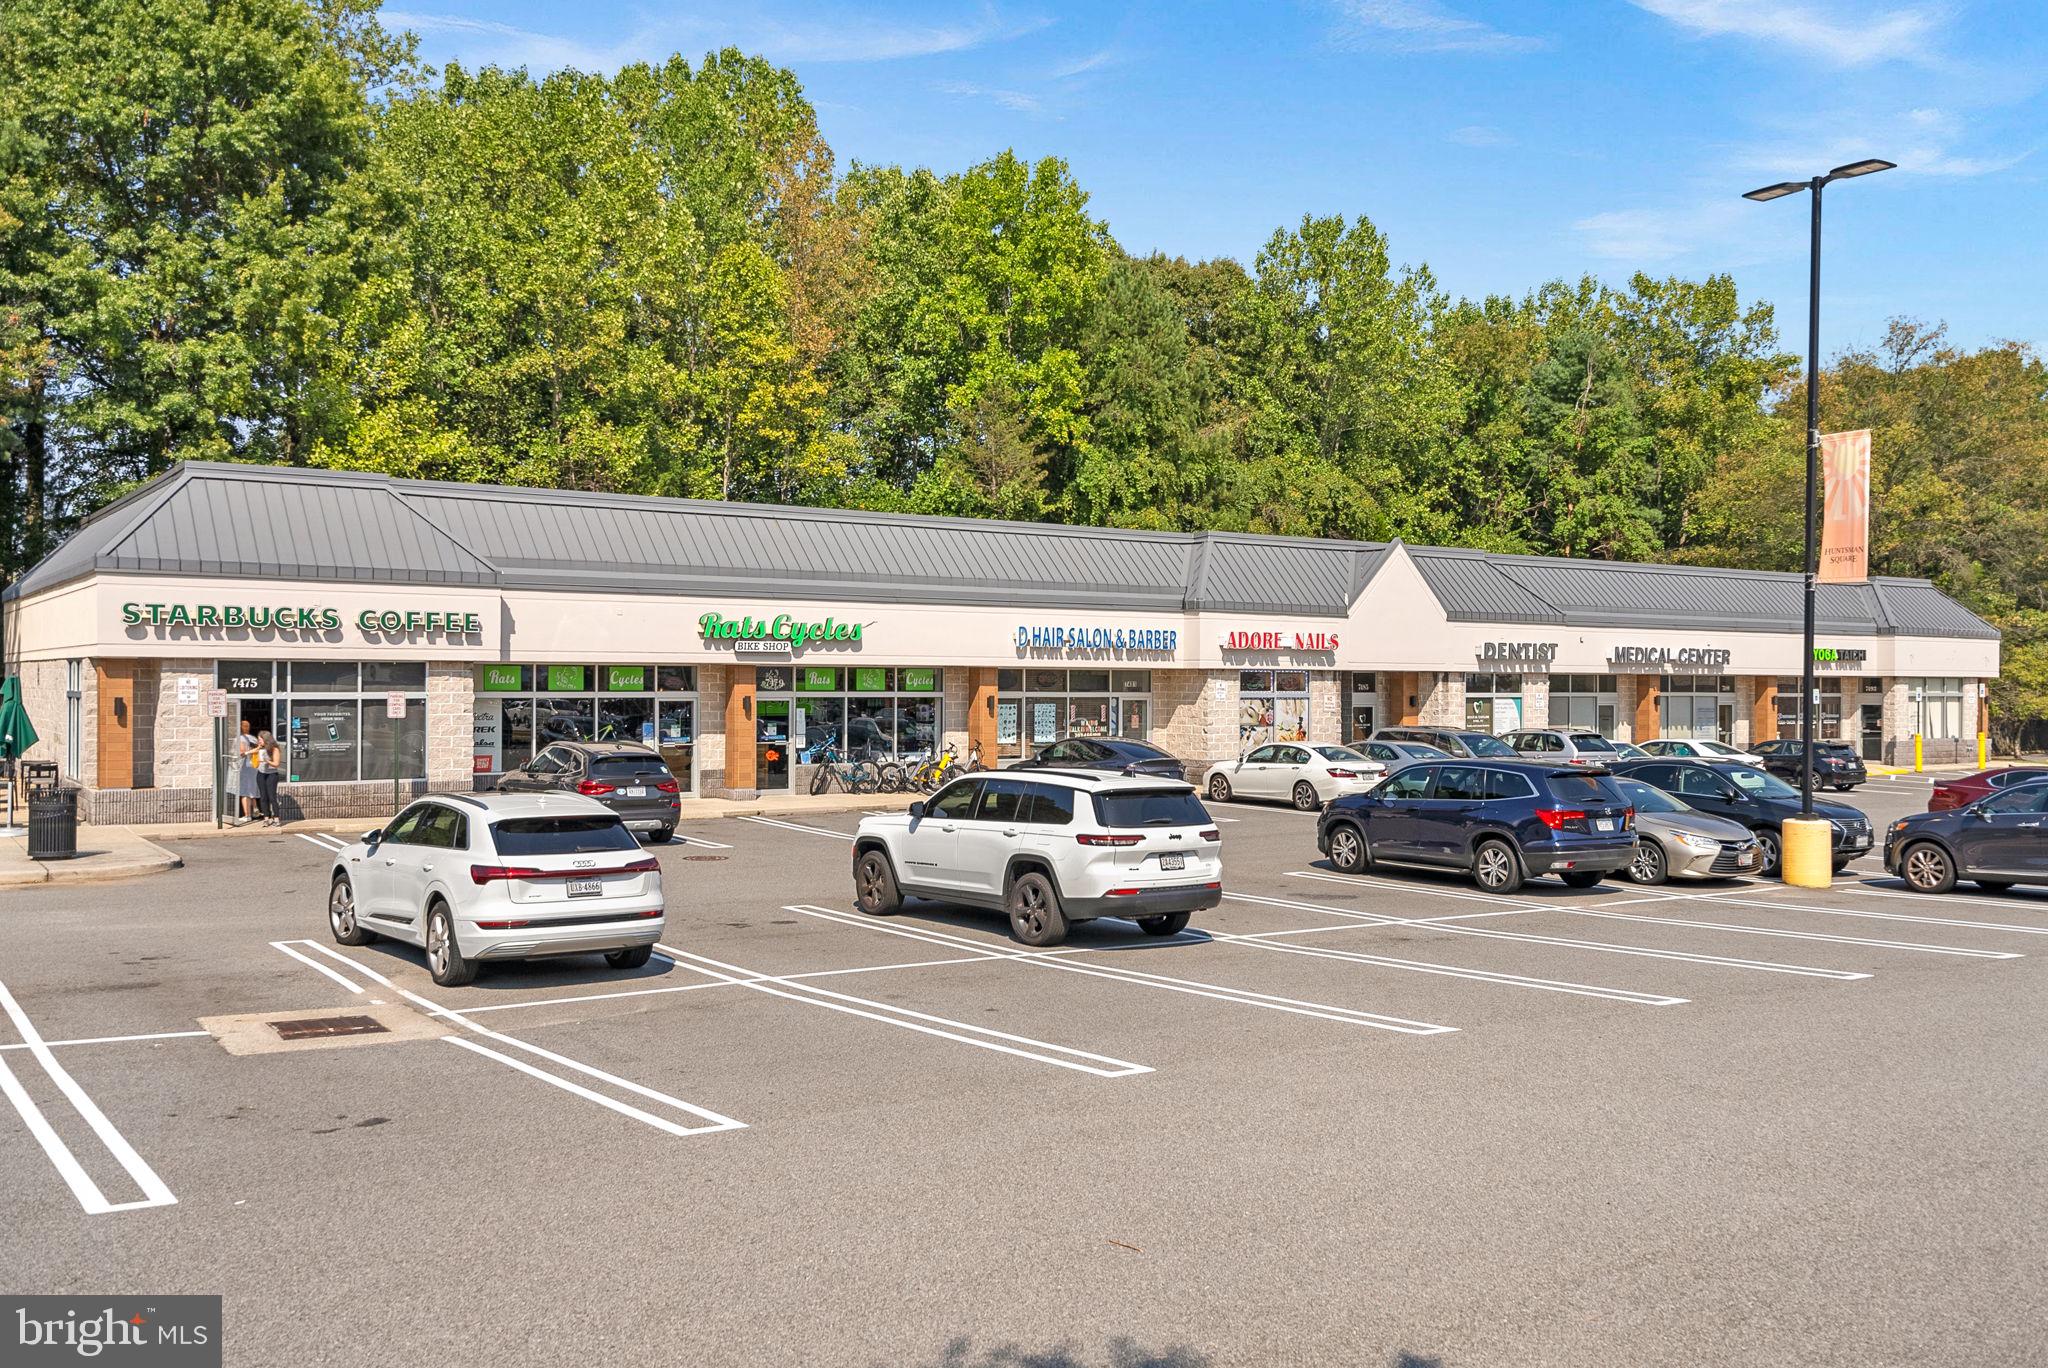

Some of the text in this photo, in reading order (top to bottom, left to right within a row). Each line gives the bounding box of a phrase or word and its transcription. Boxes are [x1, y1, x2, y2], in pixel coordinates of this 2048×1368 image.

[1824, 546, 1864, 556] HUNTSMAN
[1829, 554, 1857, 564] SQUARE
[122, 602, 480, 633] STARBUCKS COFFEE
[699, 612, 863, 648] Rats Cycles
[1018, 626, 1177, 650] D HAIR SALON & BARBER
[1226, 631, 1340, 651] ADORE NAILS
[737, 642, 789, 651] BIKE SHOP
[1483, 641, 1559, 661] DENTIST
[1614, 646, 1731, 665] MEDICAL CENTER
[1813, 648, 1838, 661] YOGA
[231, 677, 258, 688] 7475
[488, 669, 515, 685] Rats
[609, 670, 644, 686] Cycles
[808, 671, 831, 685] Rats
[906, 672, 934, 686] Cycles
[473, 738, 495, 747] alsa
[1168, 833, 1182, 841] Jeep
